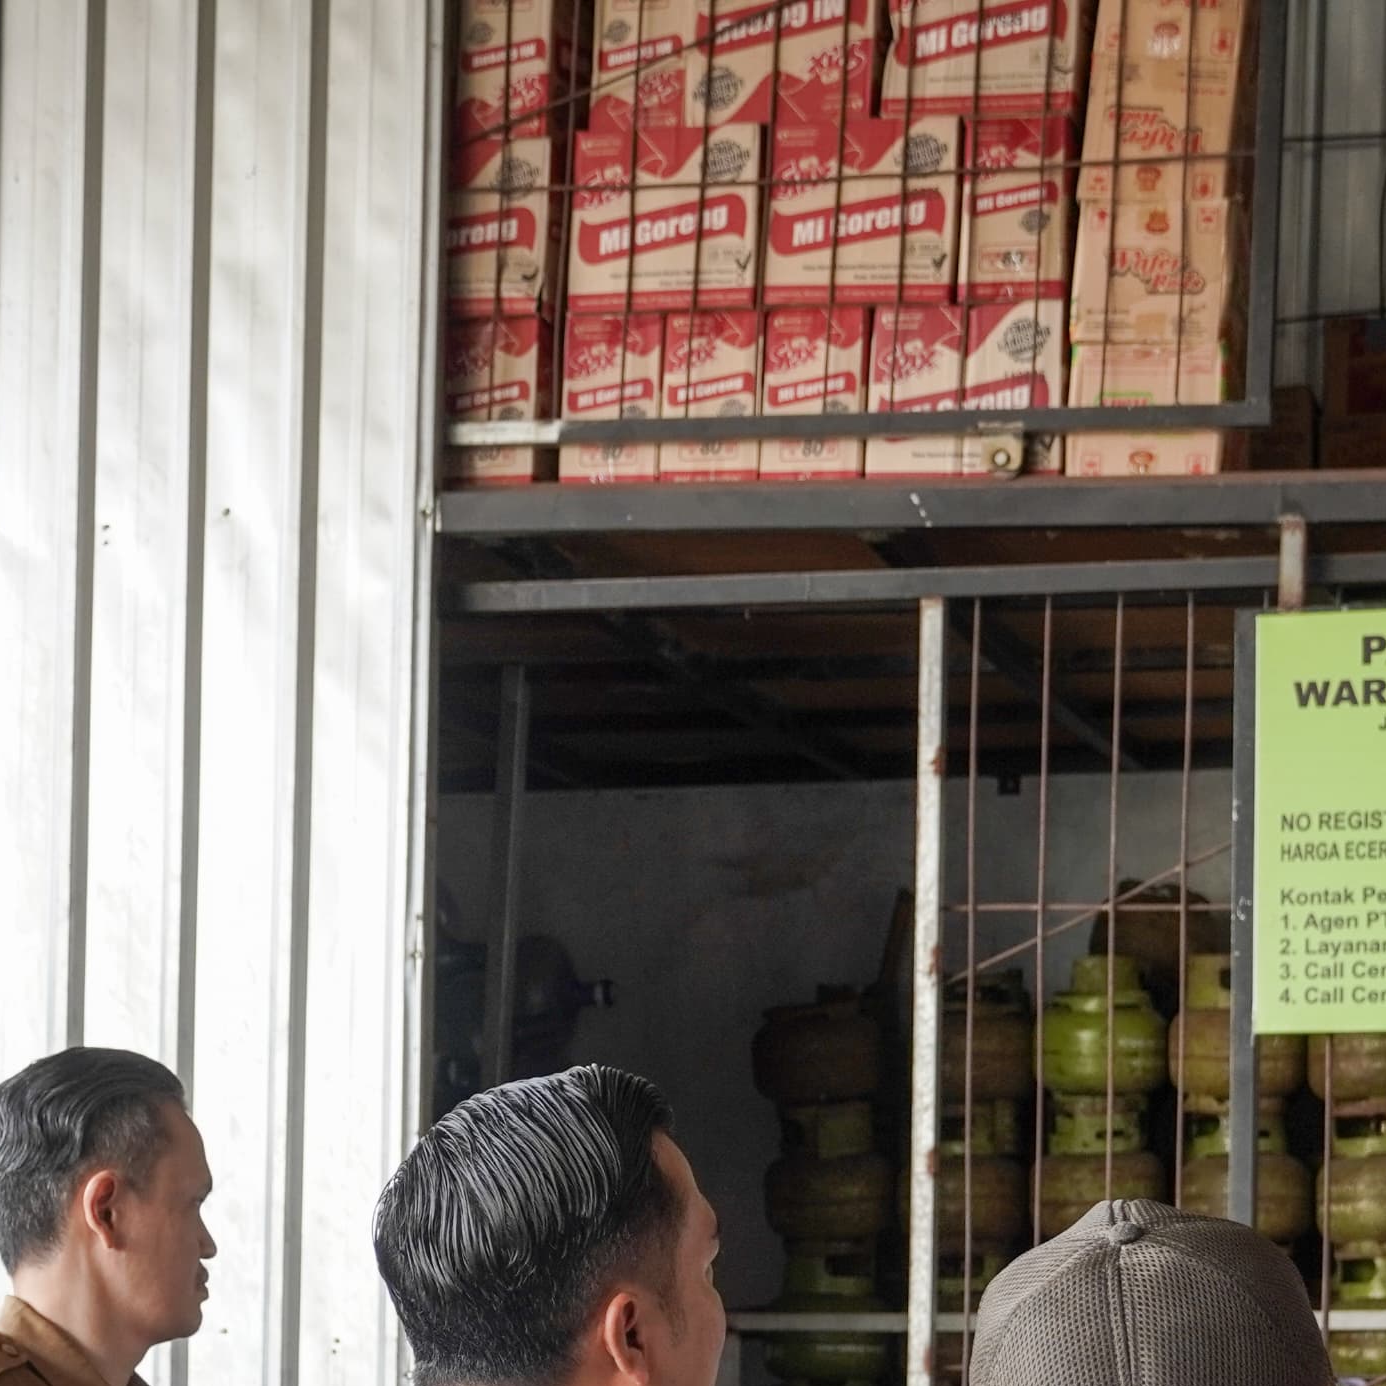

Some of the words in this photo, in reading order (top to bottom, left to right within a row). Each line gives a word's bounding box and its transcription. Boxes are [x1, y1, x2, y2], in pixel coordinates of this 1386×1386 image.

[916, 27, 947, 58] Mi
[951, 5, 1049, 49] Goreng
[598, 228, 630, 257] Mi
[633, 204, 729, 247] Goreng
[792, 217, 825, 248] Mi
[829, 199, 927, 239] Goreng
[1280, 813, 1312, 832] NO
[1280, 842, 1340, 863] HARGA
[1279, 888, 1355, 906] Kontak
[1280, 914, 1298, 932] 1.
[1304, 912, 1359, 935] Agen
[1279, 938, 1297, 956] 2.
[1279, 963, 1297, 980] 3.
[1303, 961, 1345, 980] Call
[1279, 987, 1297, 1005] 4.
[1303, 986, 1345, 1004] Call
